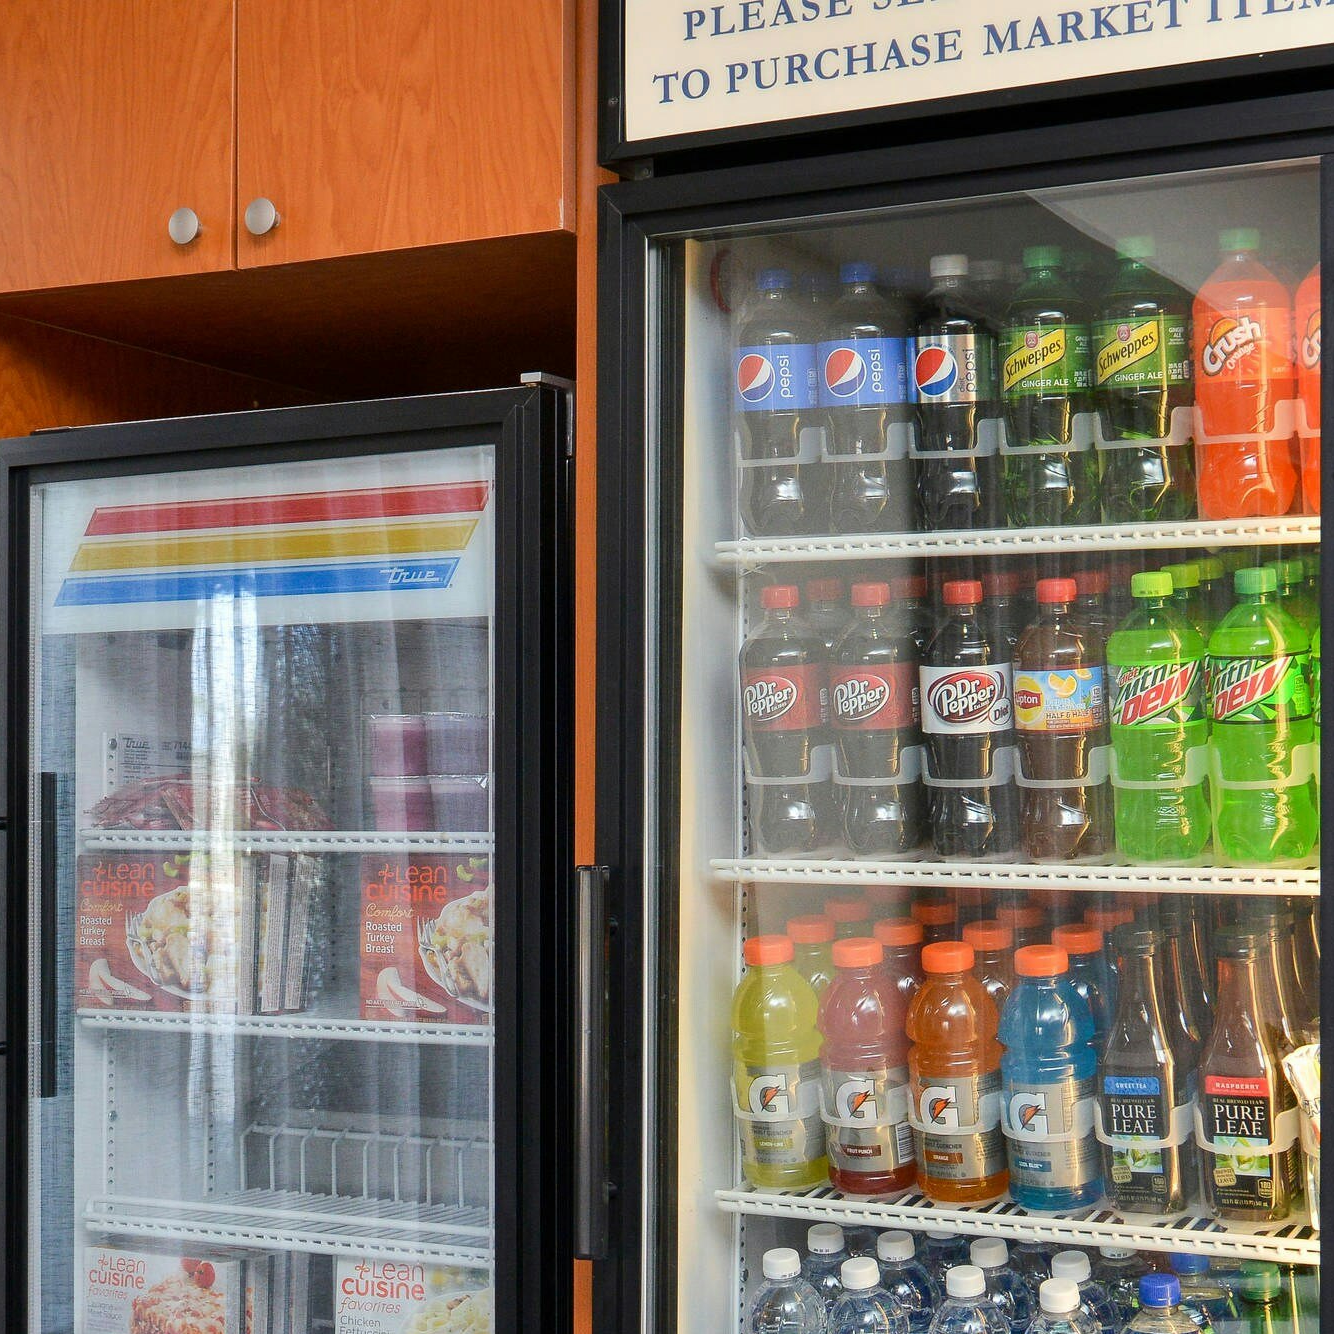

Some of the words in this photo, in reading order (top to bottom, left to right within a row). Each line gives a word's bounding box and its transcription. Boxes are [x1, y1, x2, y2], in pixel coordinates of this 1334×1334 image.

[683, 0, 853, 41] PLEASE
[653, 68, 710, 104] TO
[725, 29, 963, 95] PURCHASE
[982, 0, 1188, 56] MARKET
[1098, 331, 1157, 378] Schweppes
[1203, 315, 1262, 376] Crush
[867, 348, 885, 393] pepsi
[965, 349, 977, 393] pepsi
[1005, 340, 1063, 383] Schweppes
[776, 354, 794, 398] pepsi
[1022, 379, 1052, 388] GINGER
[1053, 378, 1069, 387] ALE
[1114, 373, 1145, 382] GINGER
[1146, 371, 1163, 380] ALE
[755, 681, 777, 699] Dr
[845, 679, 869, 699] Dr
[956, 679, 980, 700] Dr
[1122, 664, 1166, 701] Mtn
[744, 685, 793, 717] Pepper
[834, 684, 885, 717] Pepper
[938, 684, 994, 718] Pepper
[994, 707, 1009, 722] Diet
[108, 862, 155, 881] Lean
[396, 863, 447, 884] Lean
[81, 880, 156, 897] cuisine
[366, 883, 447, 902] cuisine
[80, 915, 112, 925] Roasted
[366, 902, 415, 920] Comfort
[81, 926, 106, 937] Turkey
[365, 921, 402, 932] Roasted
[79, 936, 105, 946] Breast
[366, 932, 395, 945] Turkey
[365, 943, 395, 954] Breast
[1215, 1082, 1259, 1090] RASPBERRY
[1111, 1103, 1157, 1119] PURE
[1214, 1104, 1265, 1121] PURE
[109, 1255, 146, 1274] Lean
[372, 1260, 425, 1283] Lean
[88, 1269, 145, 1290] cuisine
[341, 1277, 425, 1301] cuisine
[86, 1285, 128, 1300] favorites
[338, 1297, 401, 1315] favorites
[340, 1315, 381, 1328] Chicken
